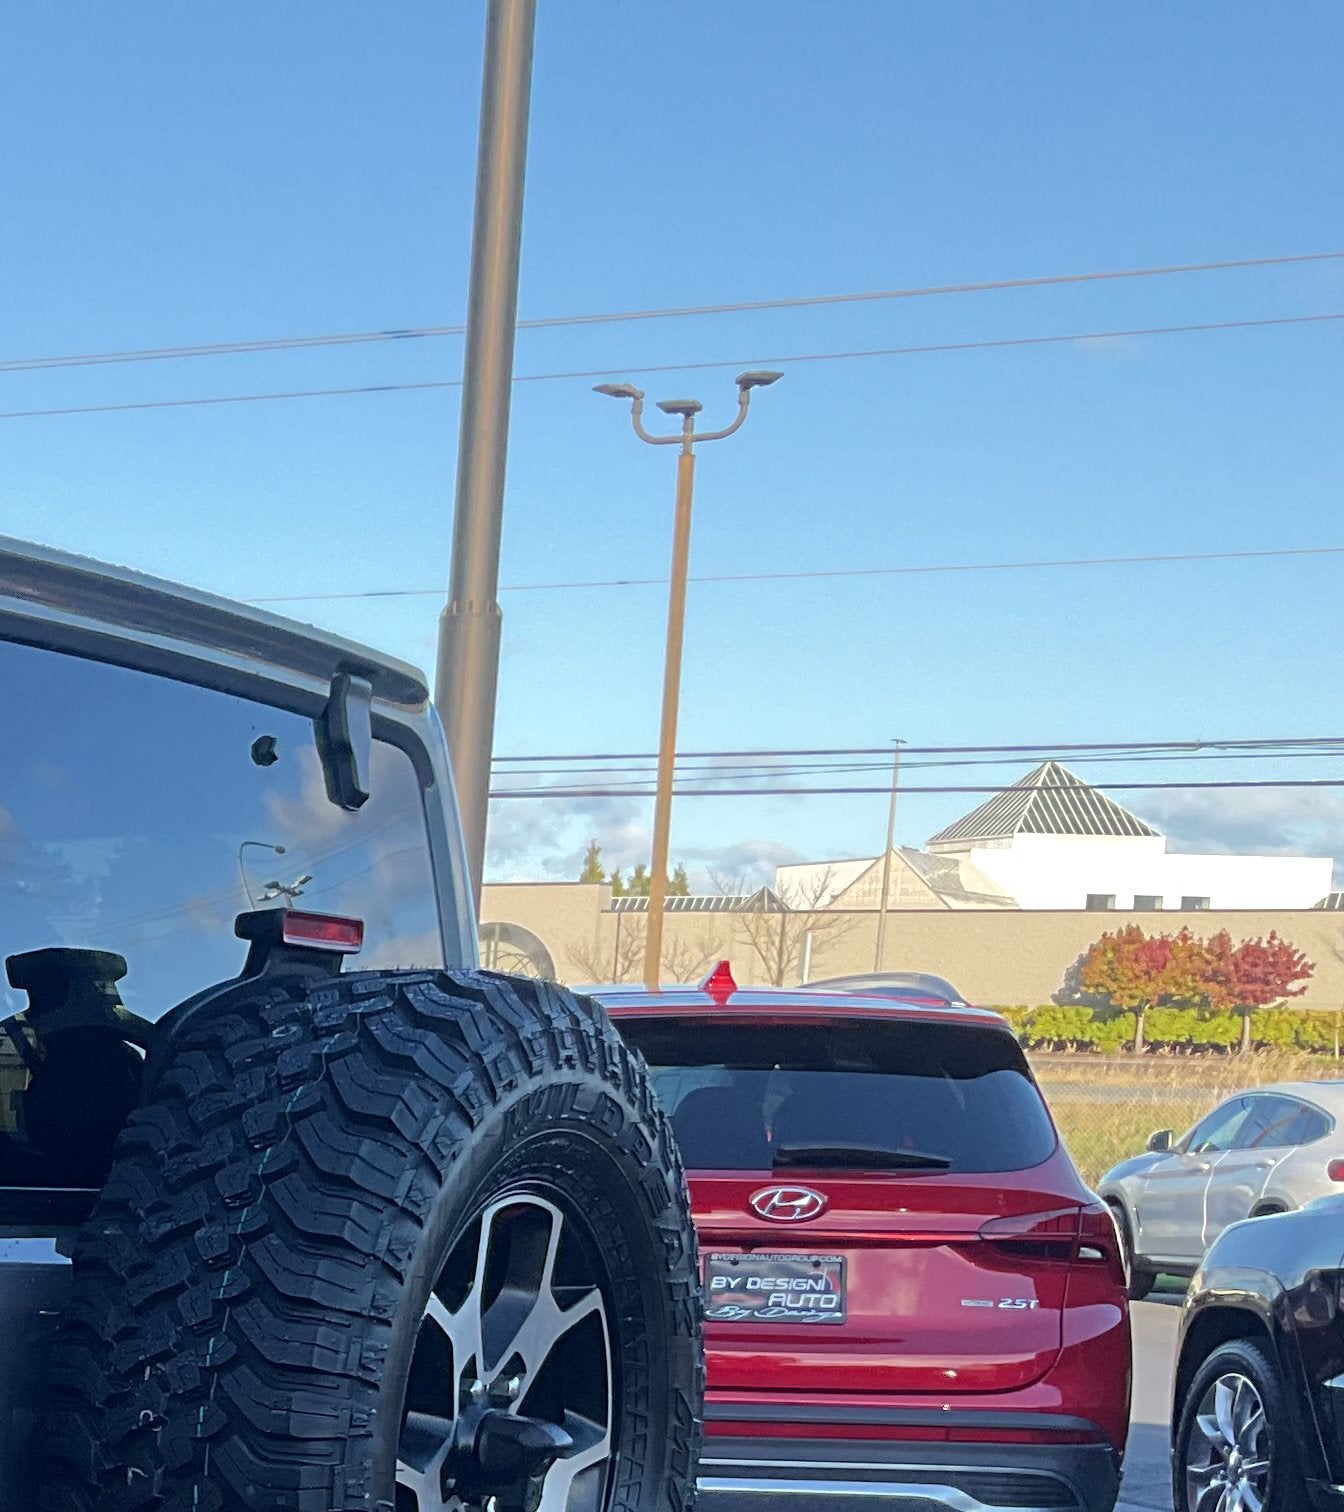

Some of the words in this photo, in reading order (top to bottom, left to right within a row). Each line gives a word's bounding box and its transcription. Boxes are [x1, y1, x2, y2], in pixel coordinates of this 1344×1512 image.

[711, 1276, 742, 1290] BY
[746, 1277, 824, 1292] DESIGN
[768, 1293, 838, 1308] AUTO
